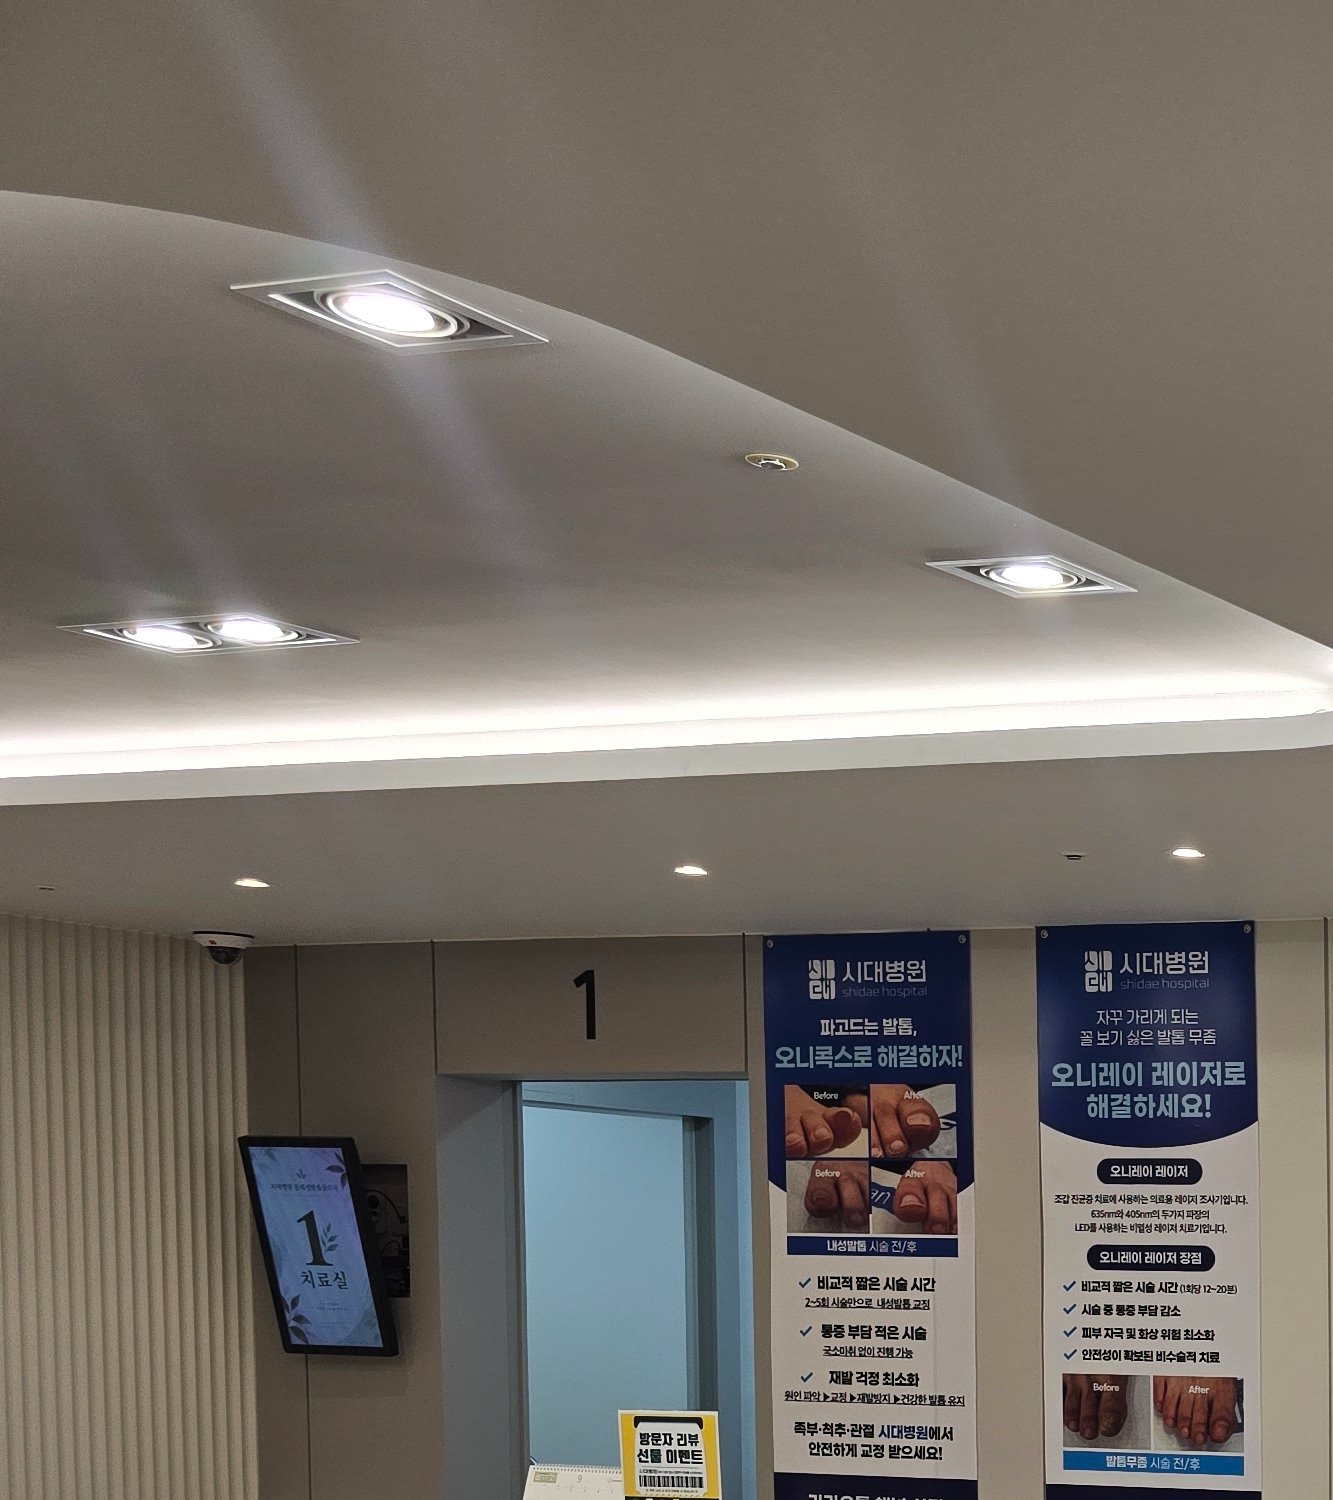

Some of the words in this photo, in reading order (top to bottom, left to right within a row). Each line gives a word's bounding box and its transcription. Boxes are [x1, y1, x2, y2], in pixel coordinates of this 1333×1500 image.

[1119, 951, 1209, 975] 시대병원
[843, 960, 926, 983] 시대병원
[843, 986, 880, 997] shidae
[882, 986, 927, 998] hospital
[1120, 979, 1159, 990] shidae
[1162, 978, 1209, 990] hospital
[573, 969, 596, 1040] 1
[1096, 1009, 1123, 1026] 자꾸
[1126, 1009, 1168, 1025] 가리게
[1170, 1009, 1199, 1025] 되는
[820, 1018, 879, 1036] 파고드는
[882, 1018, 917, 1037] 발톱,
[1080, 1031, 1093, 1046] 꼴
[1097, 1031, 1123, 1046] 보기
[1127, 1030, 1154, 1045] 싫은
[1157, 1029, 1185, 1045] 발톱
[1189, 1029, 1216, 1045] 무좀
[775, 1046, 873, 1069] 오니콕스로
[877, 1045, 963, 1068] 해결하자!
[1052, 1061, 1143, 1087] 오니레이
[1151, 1061, 1246, 1086] 레이저로
[813, 1091, 839, 1100] Before
[904, 1090, 924, 1099] After
[1086, 1093, 1211, 1119] 해결하세요!
[815, 1169, 840, 1178] Before
[905, 1170, 925, 1178] After
[1110, 1165, 1153, 1178] 오니레이
[1156, 1165, 1188, 1178] 레이저
[296, 1210, 334, 1266] 1
[1099, 1251, 1142, 1264] 오니레이
[1145, 1252, 1177, 1264] 레이저
[1180, 1252, 1202, 1265] 장점
[300, 1270, 349, 1290] 치료실
[817, 1276, 853, 1290] 비교적
[856, 1276, 880, 1291] 짧은
[883, 1277, 908, 1291] 시술
[911, 1277, 936, 1292] 시간
[1081, 1304, 1101, 1316] 시술
[1103, 1304, 1113, 1316] 중
[1116, 1305, 1136, 1316] 통증
[1138, 1305, 1158, 1317] 부담
[1160, 1306, 1181, 1317] 감소
[821, 1324, 845, 1339] 통증
[848, 1325, 872, 1339] 부담
[875, 1325, 900, 1340] 적은
[902, 1326, 927, 1341] 시술
[1082, 1327, 1102, 1339] 피부
[1104, 1328, 1124, 1339] 자극
[1126, 1328, 1136, 1340] 및
[1138, 1328, 1159, 1340] 화상
[1160, 1329, 1182, 1341] 위험
[1183, 1329, 1215, 1341] 최소화
[829, 1370, 853, 1385] 재발
[856, 1371, 880, 1386] 걱정
[882, 1372, 919, 1387] 최소화
[1093, 1383, 1120, 1392] Before
[1189, 1385, 1210, 1394] After
[639, 1433, 673, 1446] 방문자
[677, 1433, 699, 1446] 리뷰
[794, 1422, 875, 1438] 족부·척추·관절
[878, 1424, 954, 1441] 시대병원에서
[637, 1449, 662, 1463] 선물
[666, 1449, 703, 1464] 이벤트
[809, 1442, 857, 1457] 안전하게
[860, 1444, 884, 1458] 교정
[888, 1445, 943, 1460] 받으세요!
